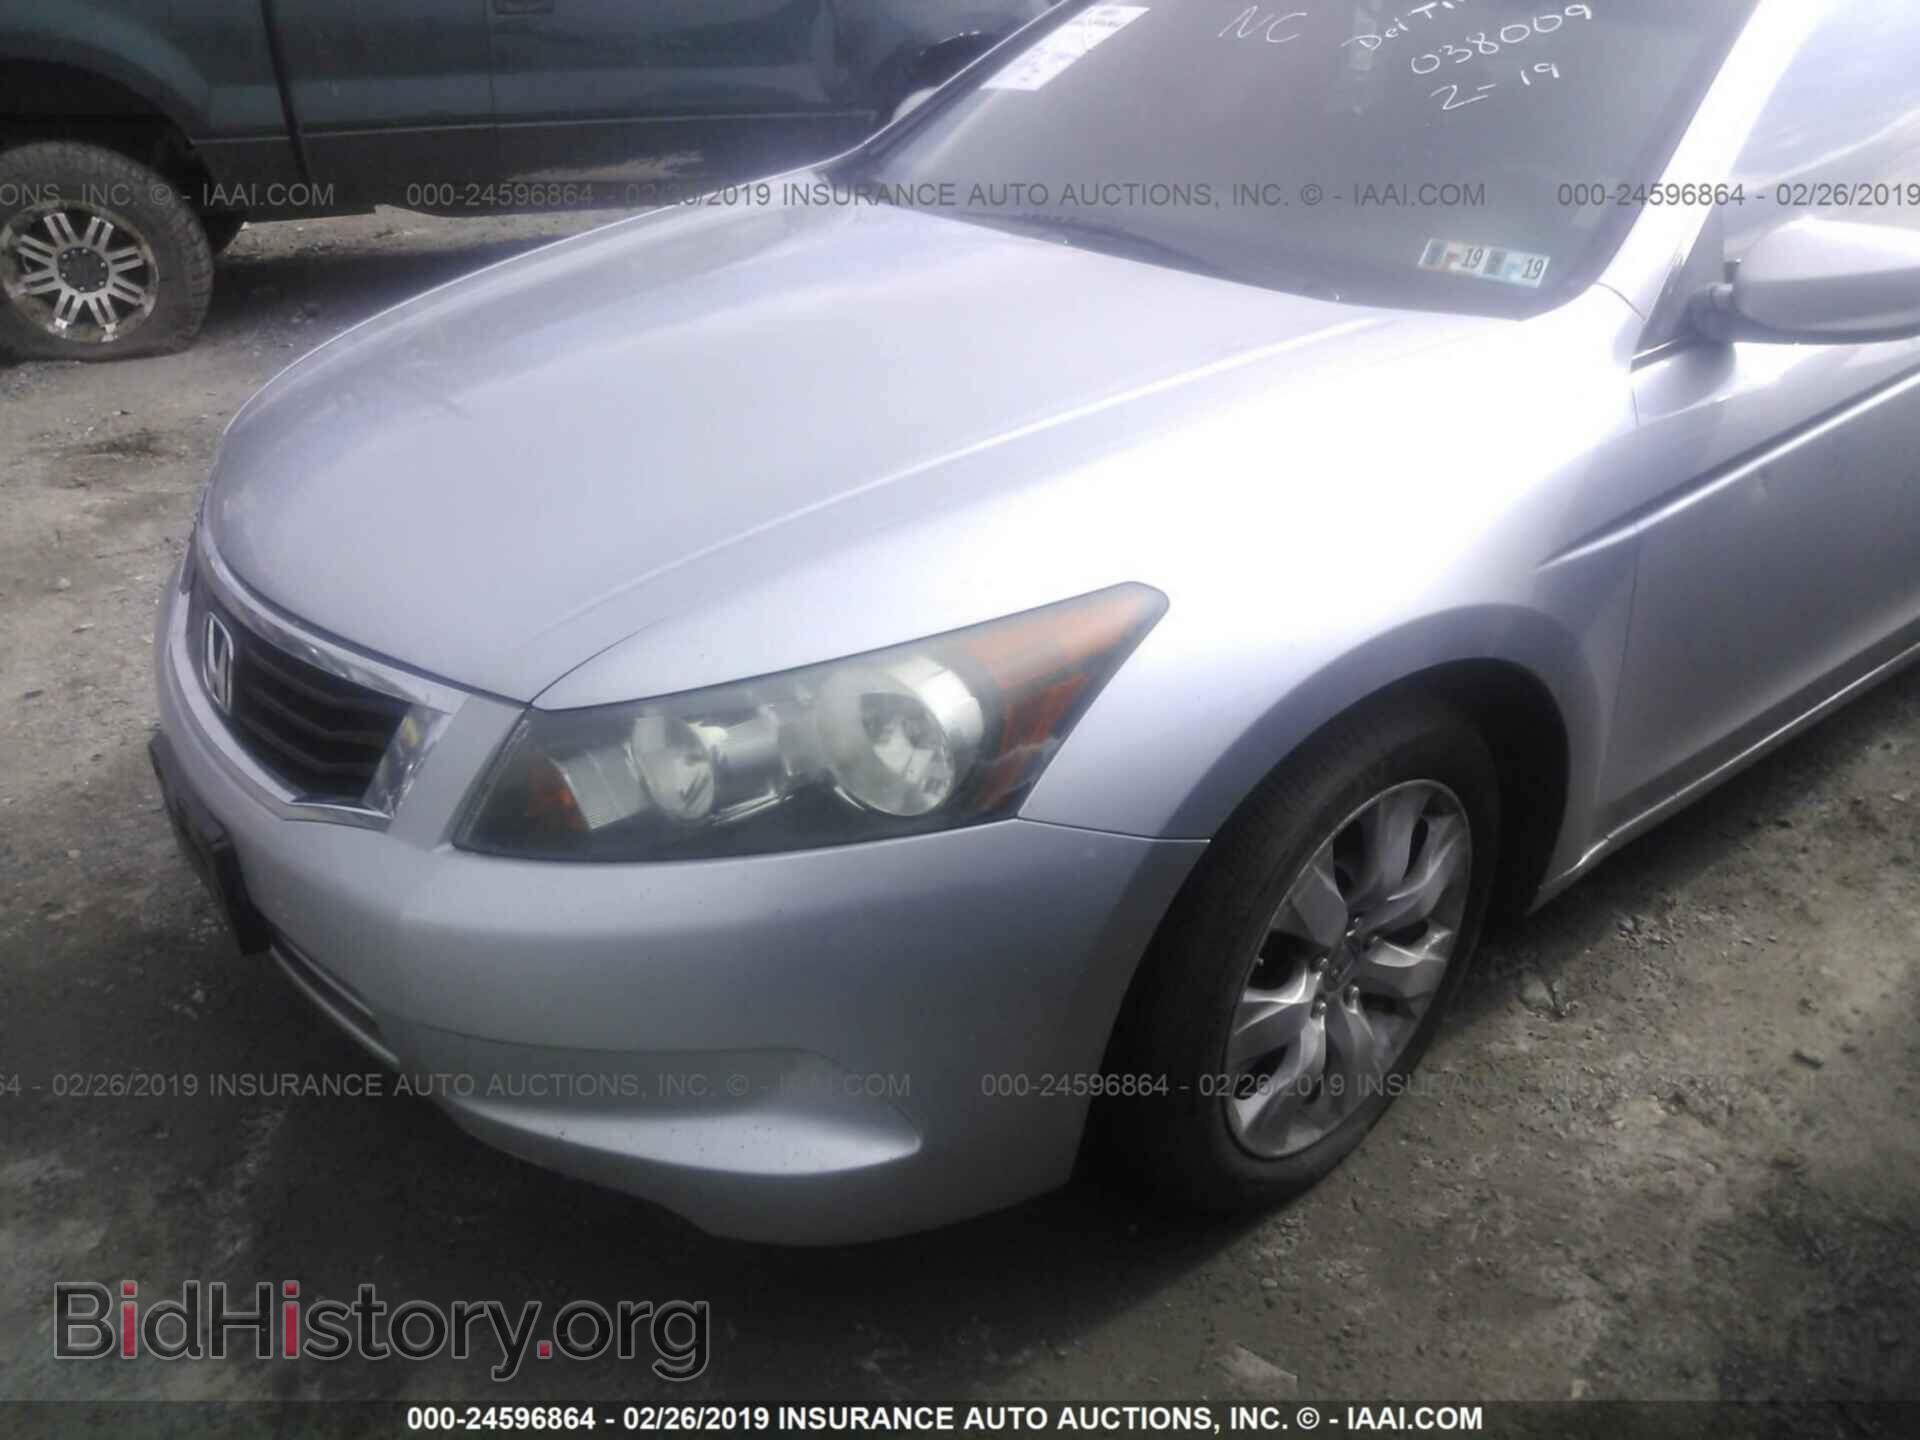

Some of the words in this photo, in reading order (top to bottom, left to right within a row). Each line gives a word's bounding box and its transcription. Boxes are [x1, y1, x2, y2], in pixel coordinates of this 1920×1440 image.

[1410, 4, 1592, 75] 038009
[1520, 62, 1560, 86] 19
[1461, 247, 1484, 269] 19
[1520, 257, 1545, 280] 19
